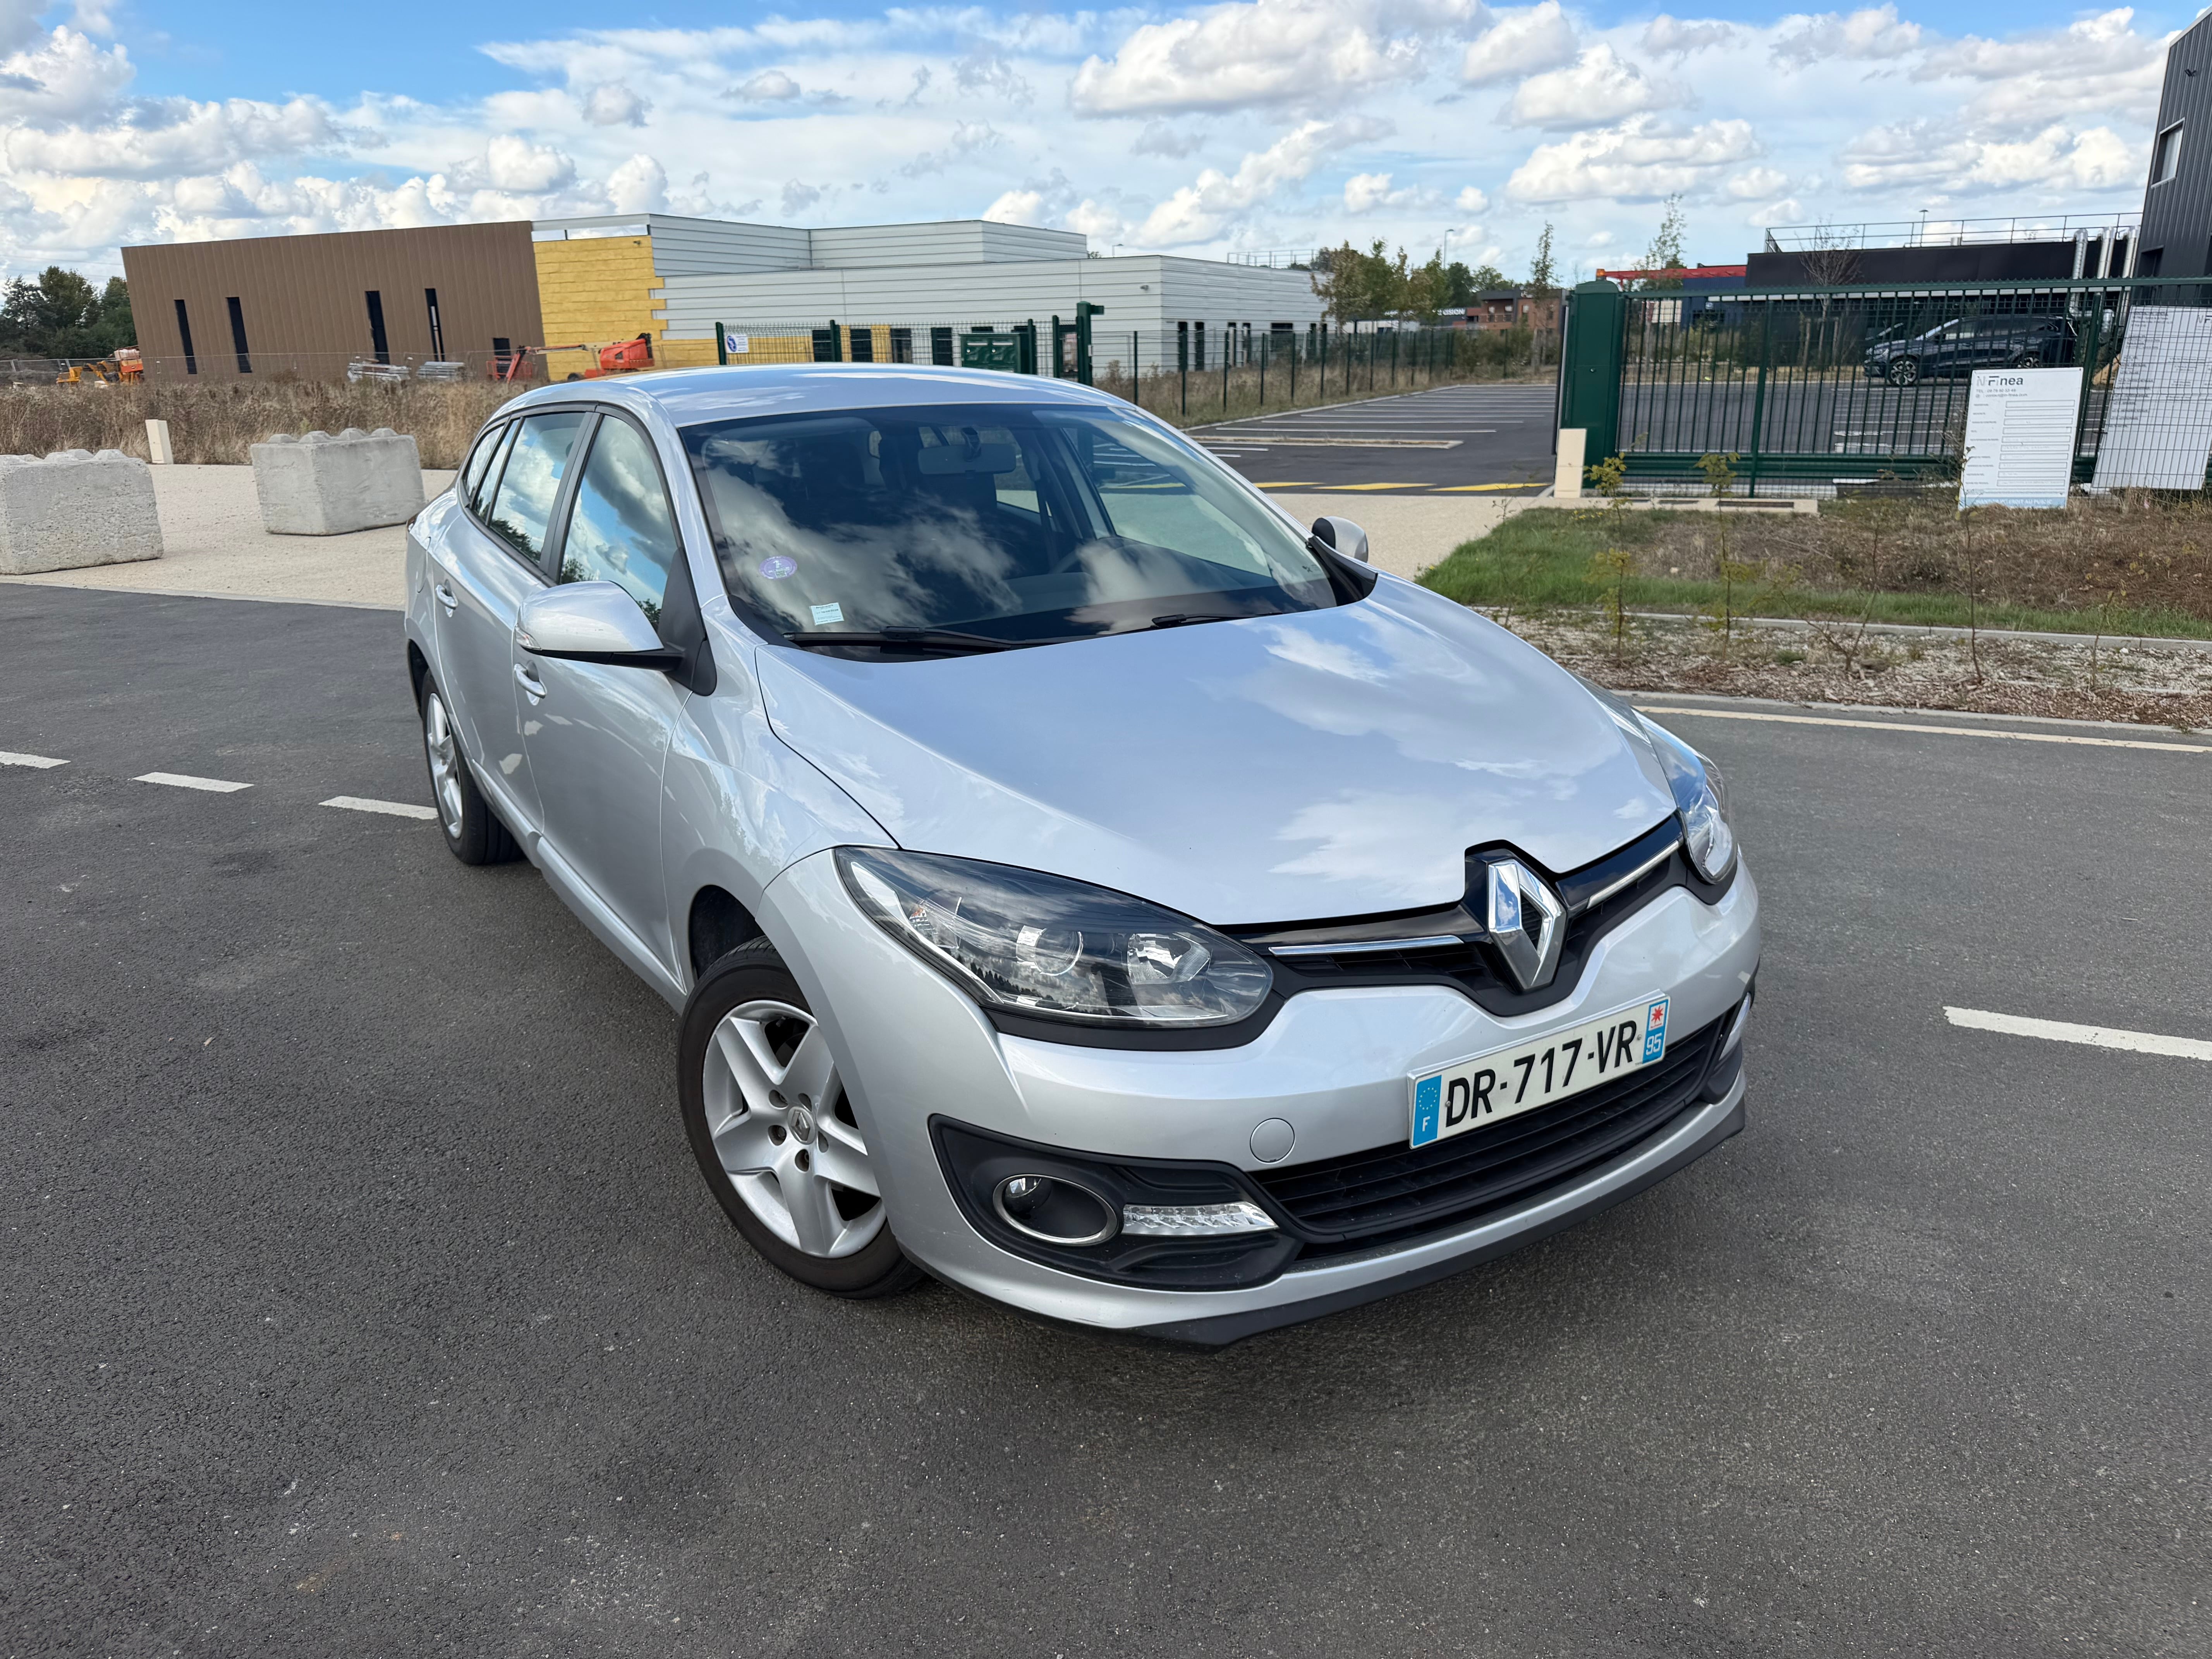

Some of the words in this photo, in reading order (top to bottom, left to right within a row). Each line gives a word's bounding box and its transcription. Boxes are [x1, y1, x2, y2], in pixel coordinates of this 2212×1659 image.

[1646, 1032, 1662, 1056] 95
[1446, 1020, 1637, 1128] DR-717-VR
[1422, 1116, 1431, 1132] F
